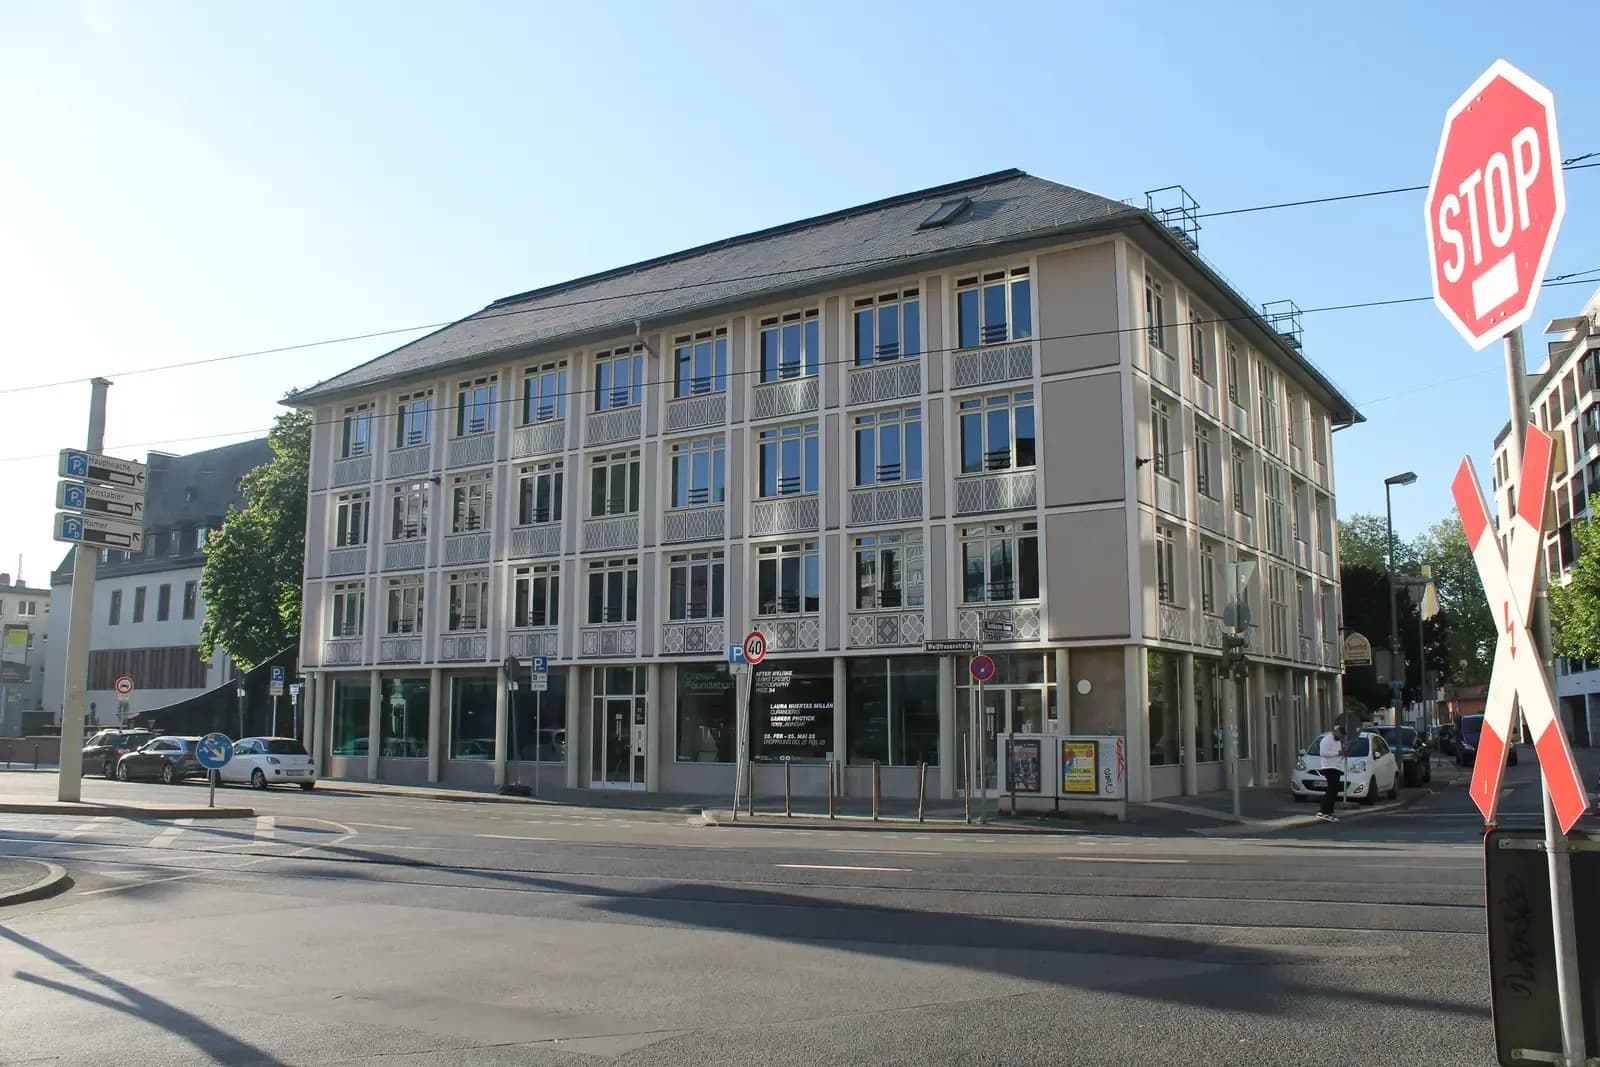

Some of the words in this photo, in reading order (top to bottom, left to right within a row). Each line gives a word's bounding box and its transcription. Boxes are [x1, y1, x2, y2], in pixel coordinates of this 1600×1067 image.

[1439, 126, 1540, 283] STOP
[89, 455, 131, 472] Hauptwache
[87, 487, 125, 500] Konstabler
[733, 646, 743, 661] P
[748, 640, 762, 655] 40
[534, 658, 543, 671] P
[273, 668, 281, 679] P
